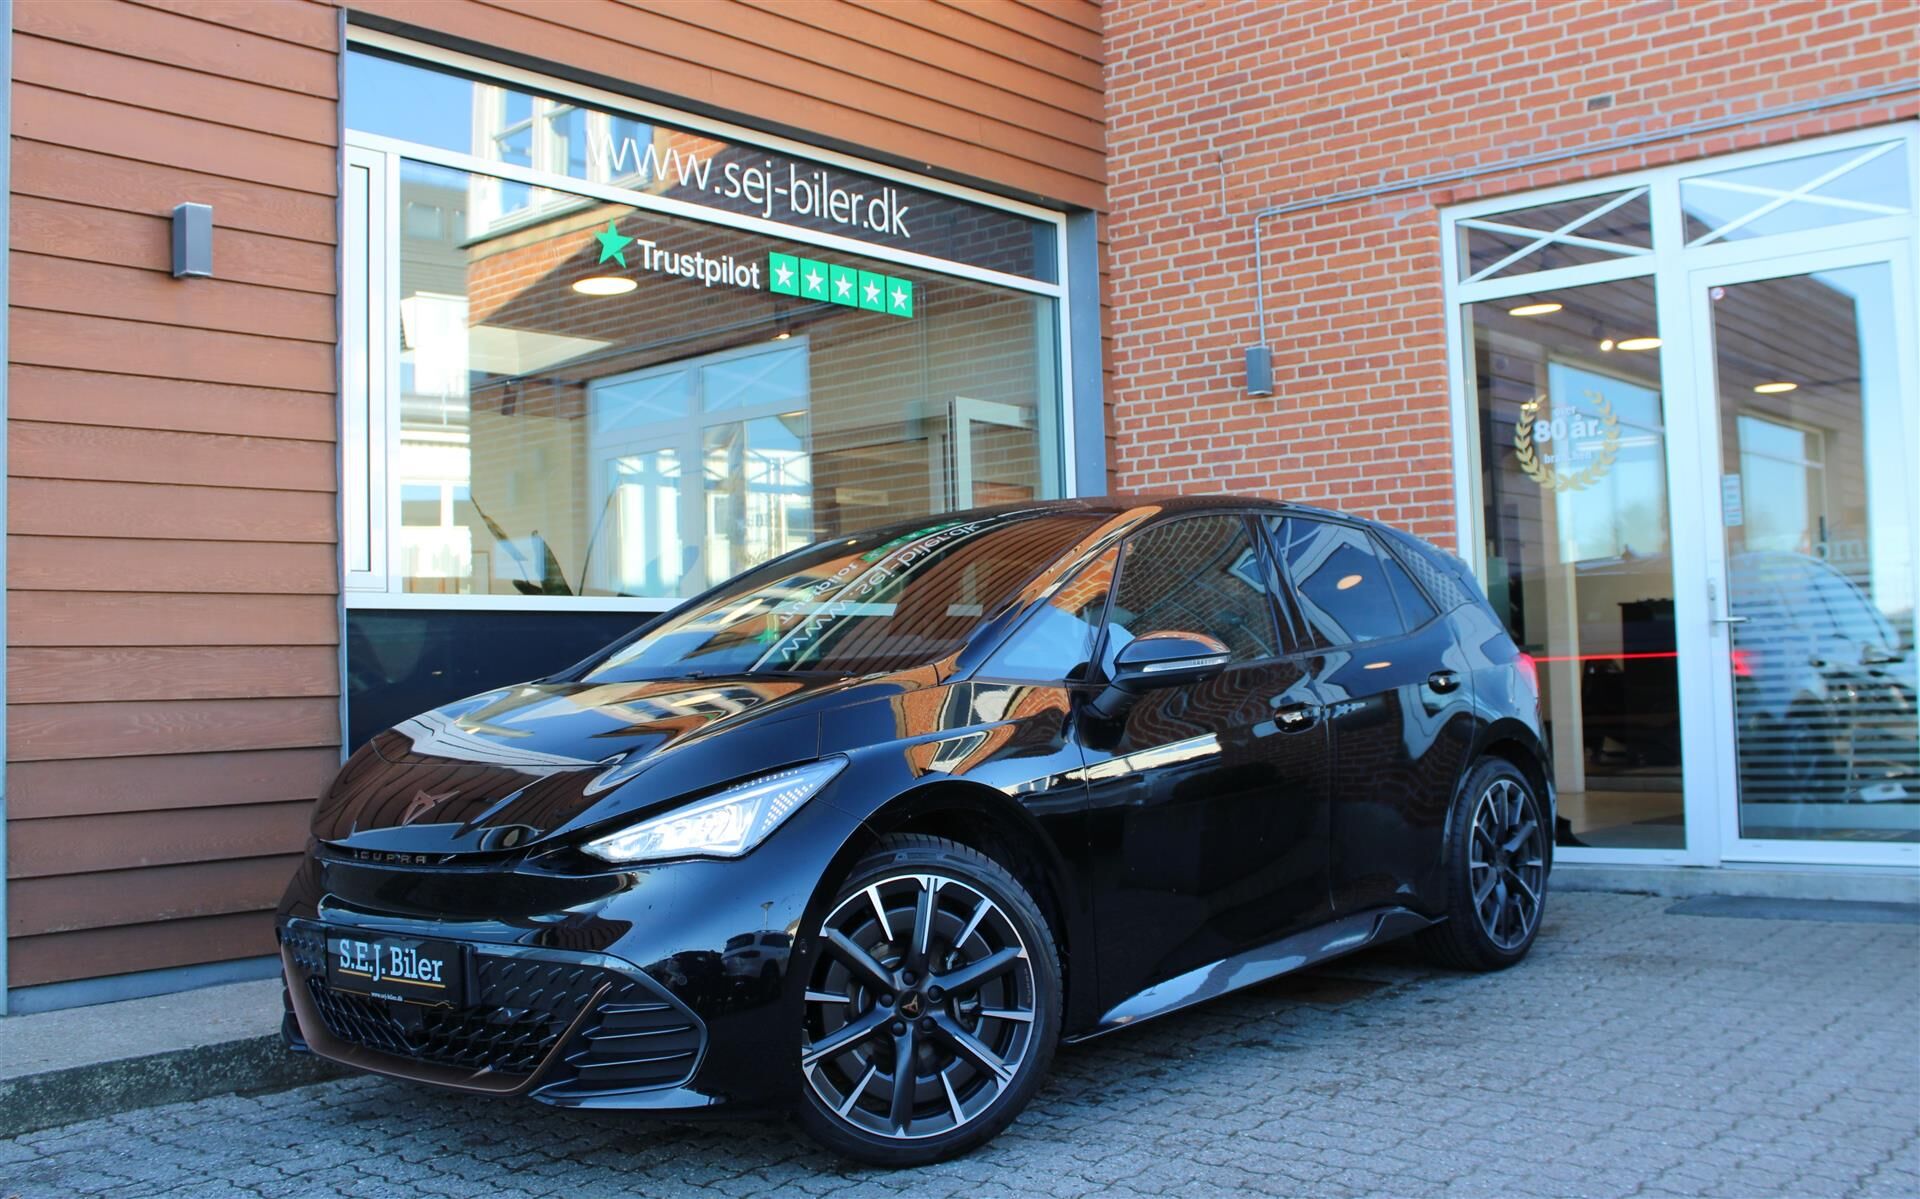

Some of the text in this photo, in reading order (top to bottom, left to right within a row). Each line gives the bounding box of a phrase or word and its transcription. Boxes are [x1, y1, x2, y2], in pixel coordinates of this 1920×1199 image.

[586, 127, 911, 239] www.sej-biler.dk
[637, 239, 761, 290] Trustpilot
[1533, 418, 1567, 442] 80
[340, 938, 443, 982] S.E.J. Biler
